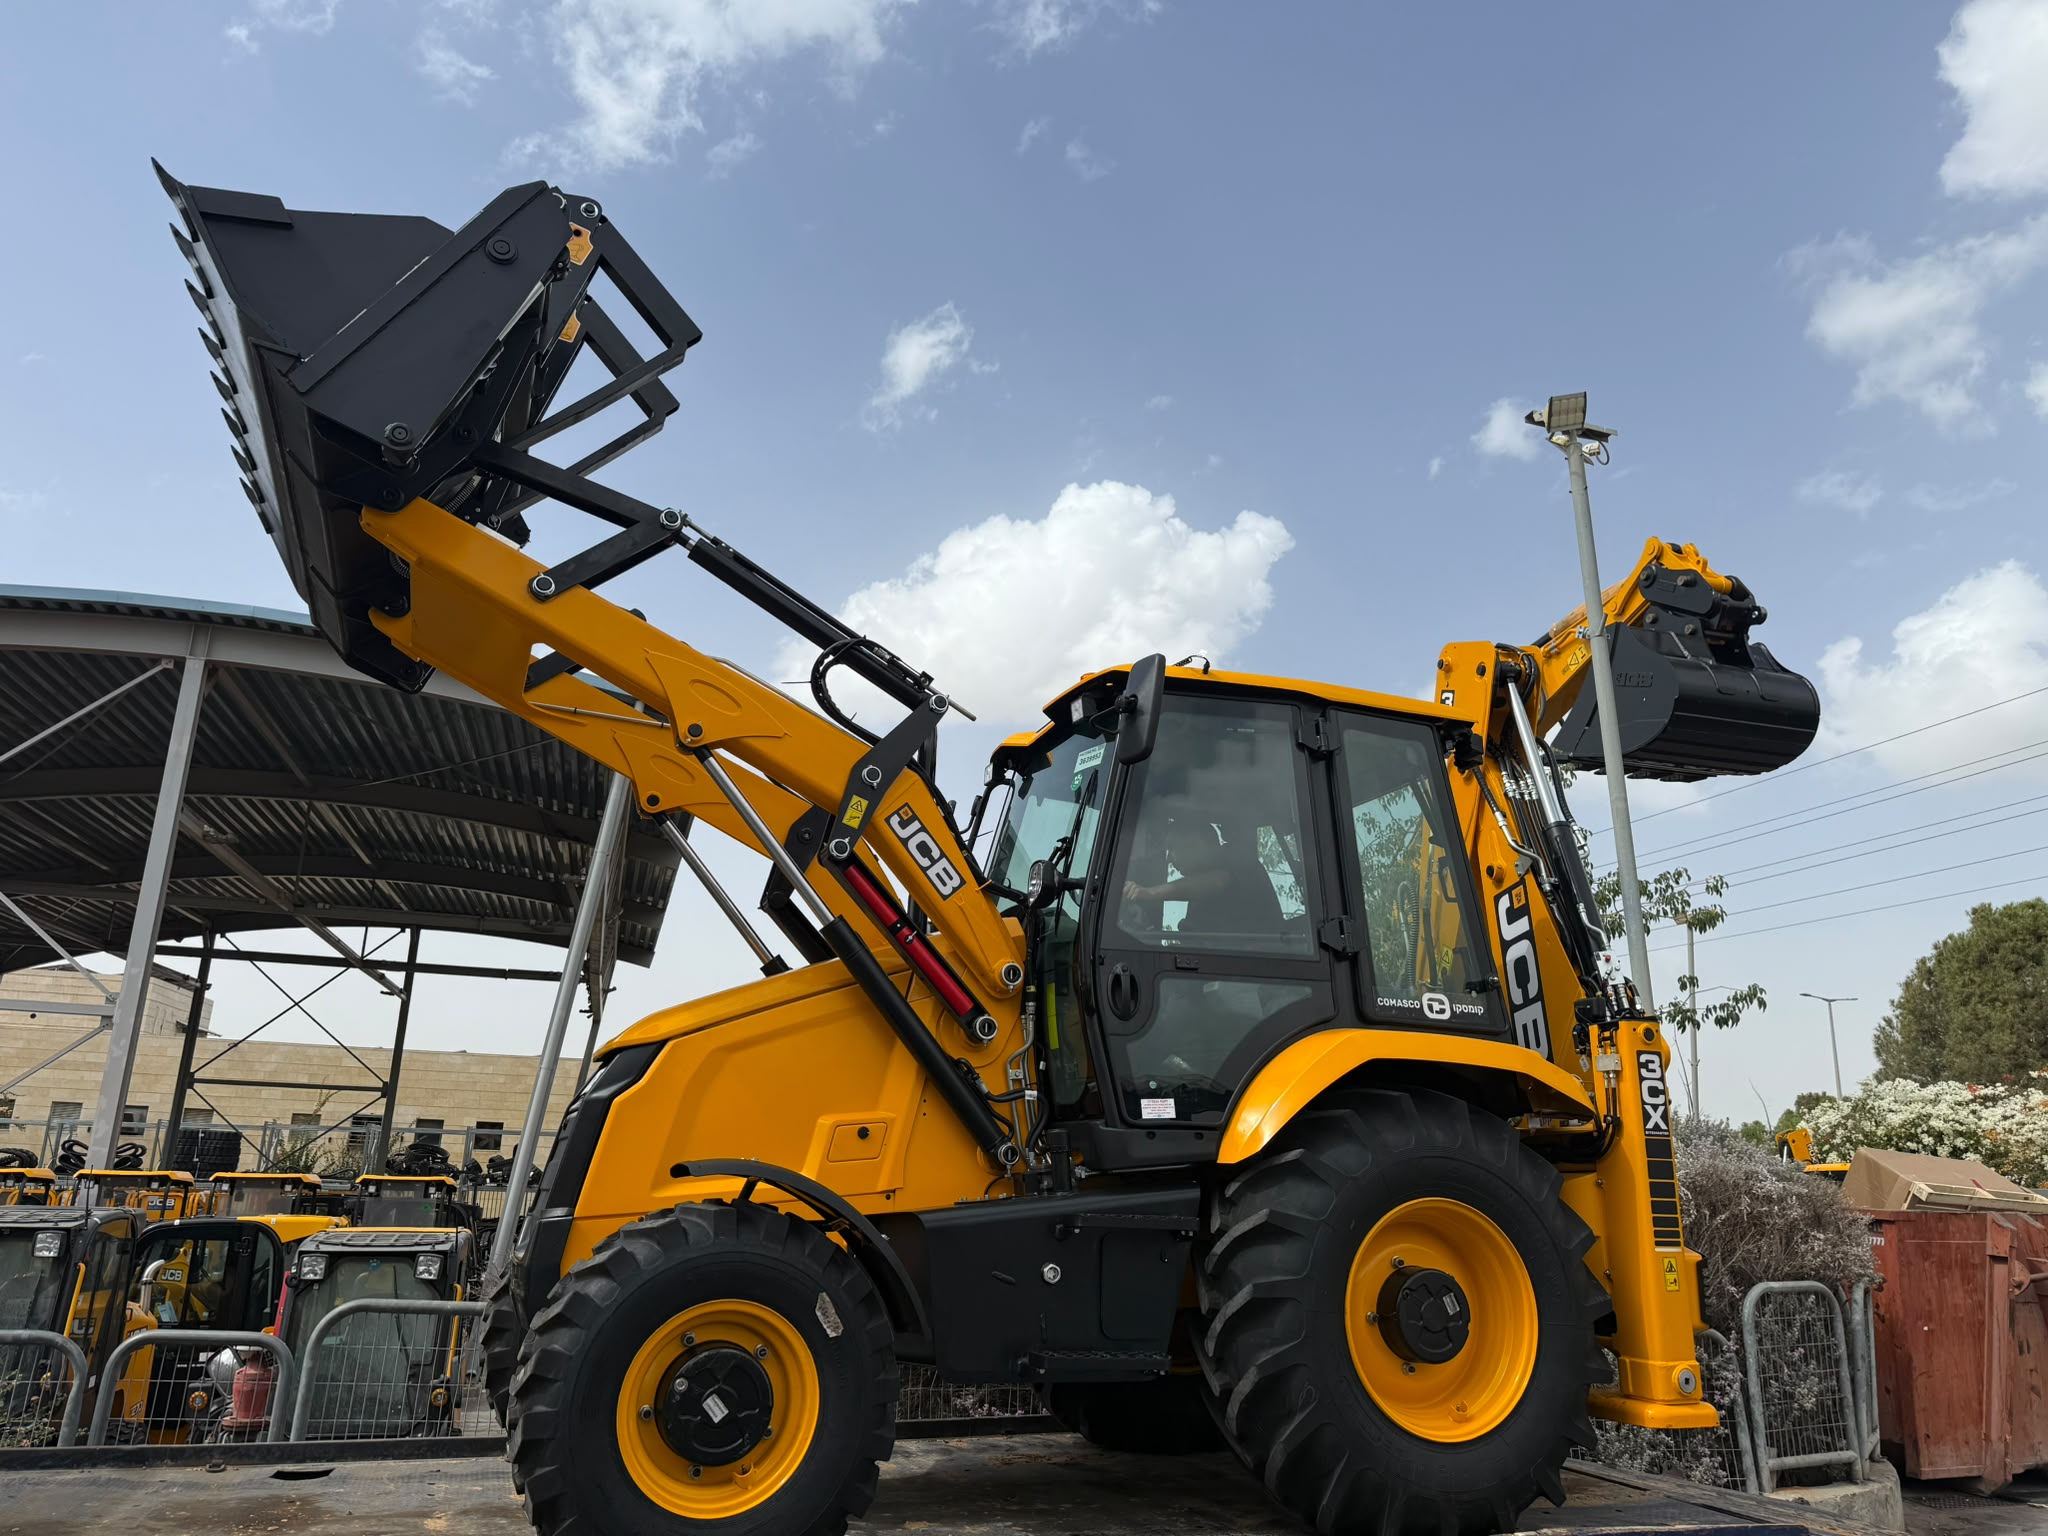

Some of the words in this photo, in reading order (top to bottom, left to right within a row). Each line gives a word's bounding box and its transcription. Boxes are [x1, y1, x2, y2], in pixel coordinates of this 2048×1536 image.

[889, 813, 961, 896] JCB
[1498, 892, 1549, 1061] JCB
[1377, 997, 1420, 1009] COMASCO
[1453, 1003, 1484, 1016] קומסקו
[1639, 1053, 1668, 1129] 3CX
[148, 1198, 175, 1206] JCB
[161, 1269, 183, 1281] JCB
